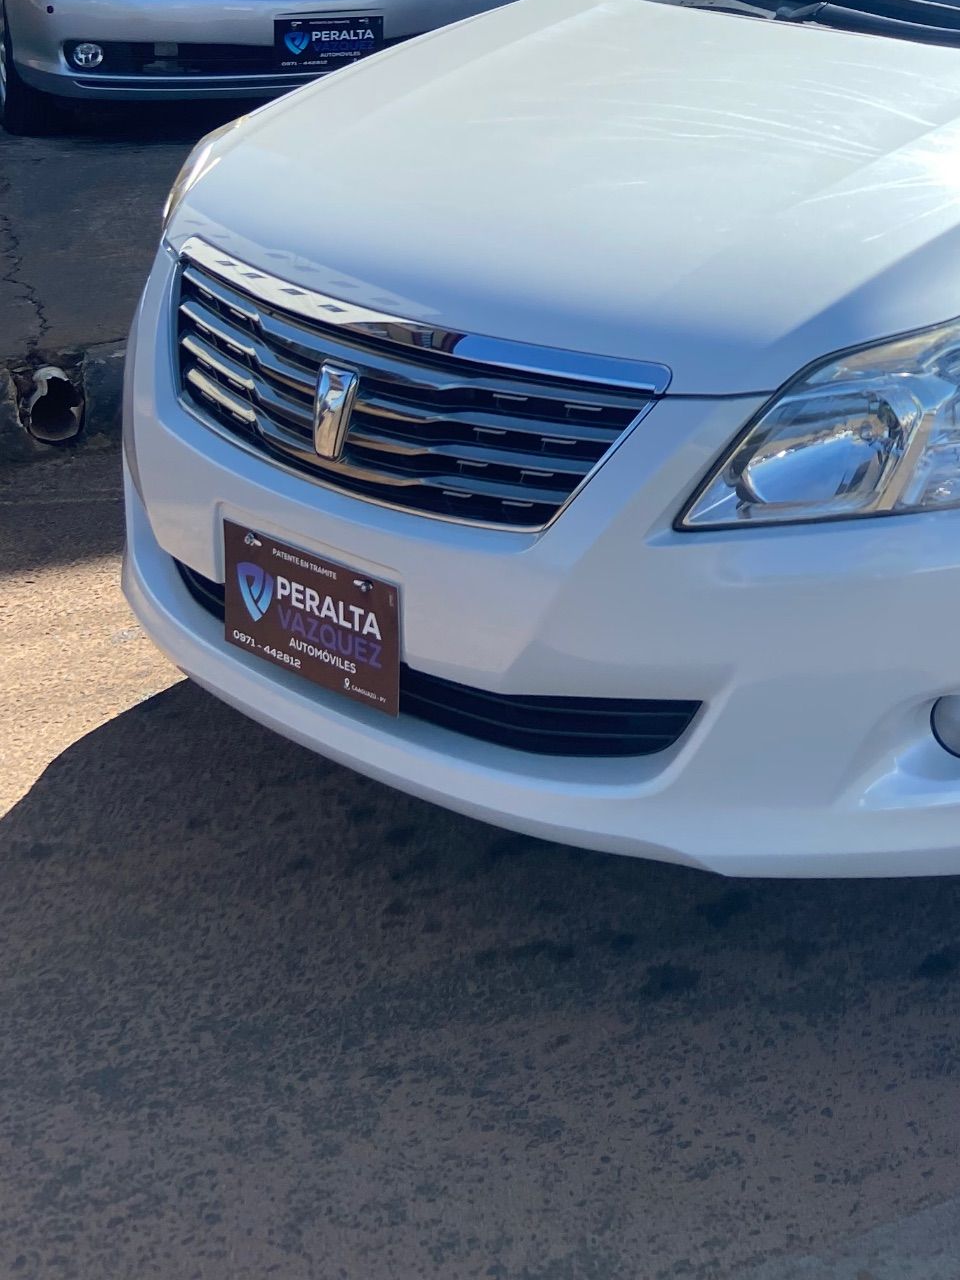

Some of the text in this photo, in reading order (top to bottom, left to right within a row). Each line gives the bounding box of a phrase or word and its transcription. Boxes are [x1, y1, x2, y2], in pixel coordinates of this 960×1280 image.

[311, 29, 375, 42] PERALTA
[272, 547, 337, 580] PATENTE EN TRAMITE
[276, 575, 381, 640] PERALTA
[233, 629, 256, 647] 0971
[264, 645, 302, 669] 442812
[278, 604, 382, 667] VAZQUEZ
[289, 637, 357, 674] AUTOMÓVILES
